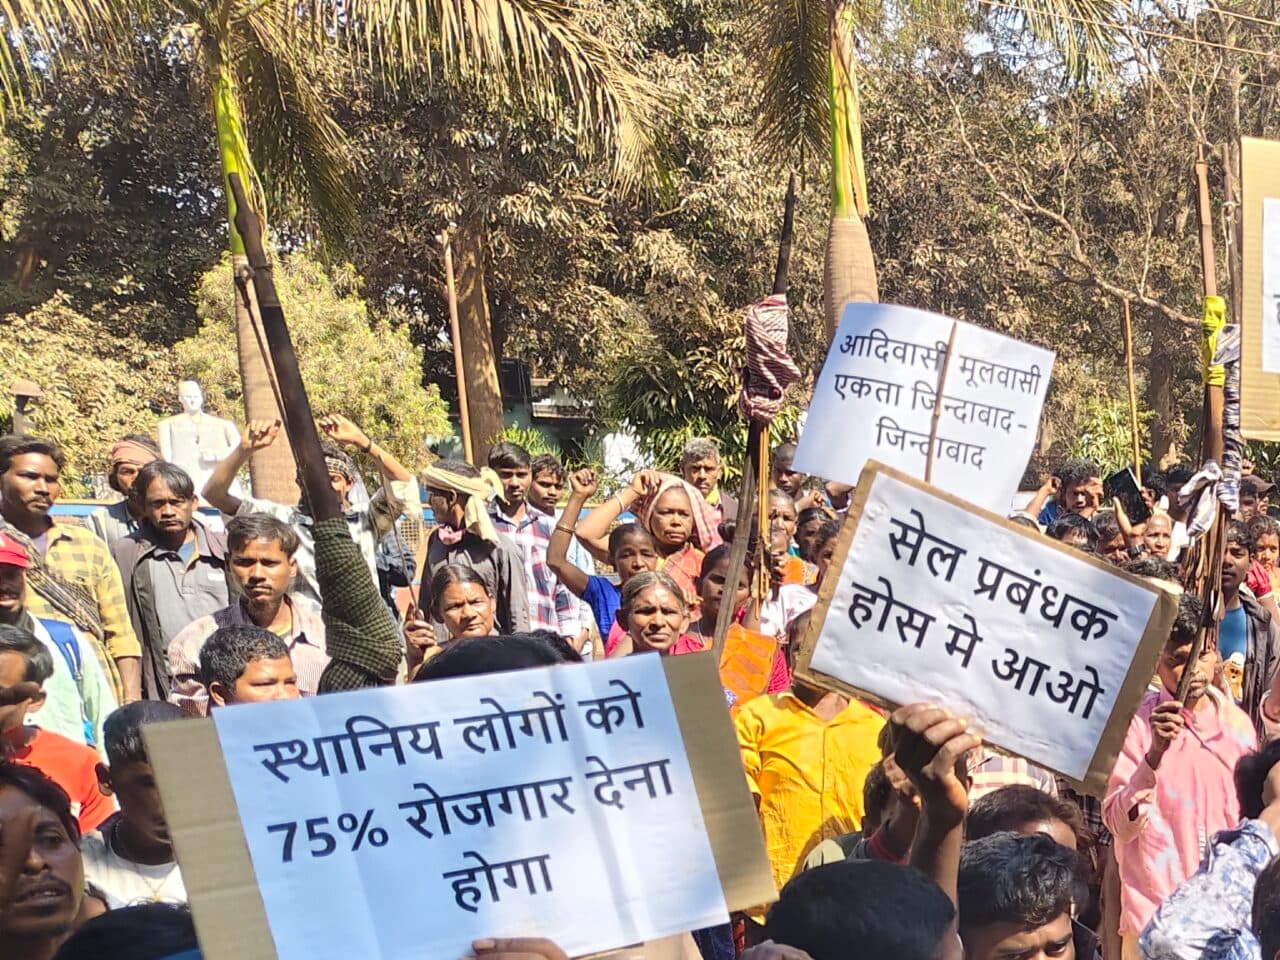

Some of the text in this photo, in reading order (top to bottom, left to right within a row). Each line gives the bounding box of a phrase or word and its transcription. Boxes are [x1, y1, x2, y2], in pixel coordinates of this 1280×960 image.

[834, 373, 904, 407] एकता
[957, 354, 1042, 396] मूलवासी
[888, 509, 1119, 642] सेल प्रबंधक
[847, 577, 1105, 720] होस मे आओ
[254, 679, 645, 784] स्थानिय लोगों को
[267, 755, 676, 863] 75% रोजगार देना
[442, 850, 555, 914] होगा
